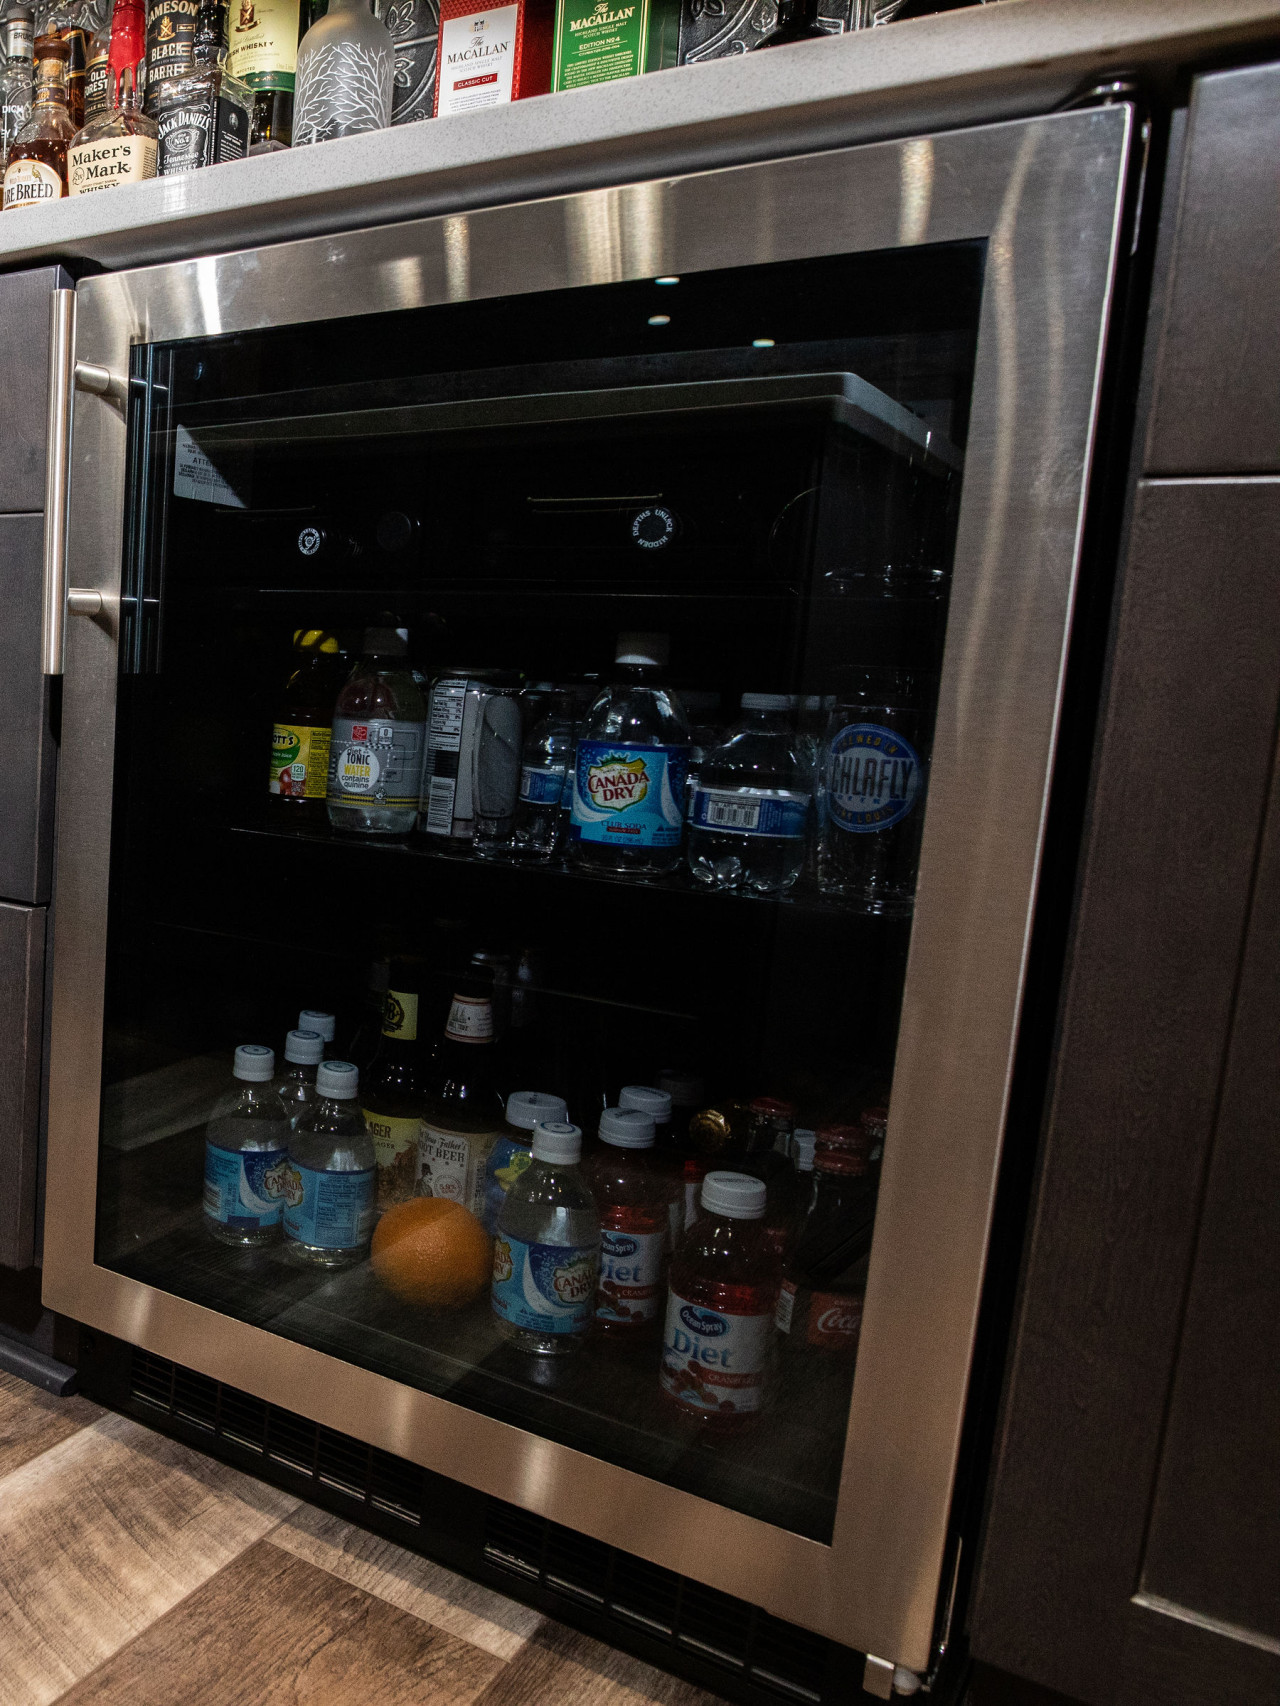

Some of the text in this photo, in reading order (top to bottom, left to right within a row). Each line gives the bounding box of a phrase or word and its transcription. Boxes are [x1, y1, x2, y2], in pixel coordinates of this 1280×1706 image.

[148, 1, 198, 29] JAMESON
[570, 6, 635, 32] MACALLAN
[151, 43, 183, 61] BLACK
[447, 41, 508, 64] MACALLAN
[579, 40, 605, 50] EDITION
[91, 70, 106, 82] OLD
[457, 79, 480, 87] CLASSIC
[158, 116, 179, 140] JACK
[72, 146, 131, 167] Maker's
[163, 152, 199, 165] Tennessee
[86, 162, 130, 180] Mark
[163, 163, 198, 176] WHISKEY
[16, 183, 54, 200] BREED
[347, 753, 370, 765] TONIC
[293, 765, 304, 773] 120
[344, 764, 371, 777] WATER
[341, 775, 370, 783] contains
[587, 771, 650, 793] CANADA
[832, 755, 914, 800] CHLAFLY
[603, 785, 636, 801] DRY
[601, 820, 647, 830] CLUB SODA
[436, 1148, 465, 1162] BEER
[701, 1320, 724, 1335] Spray
[672, 1328, 732, 1369] Diet
